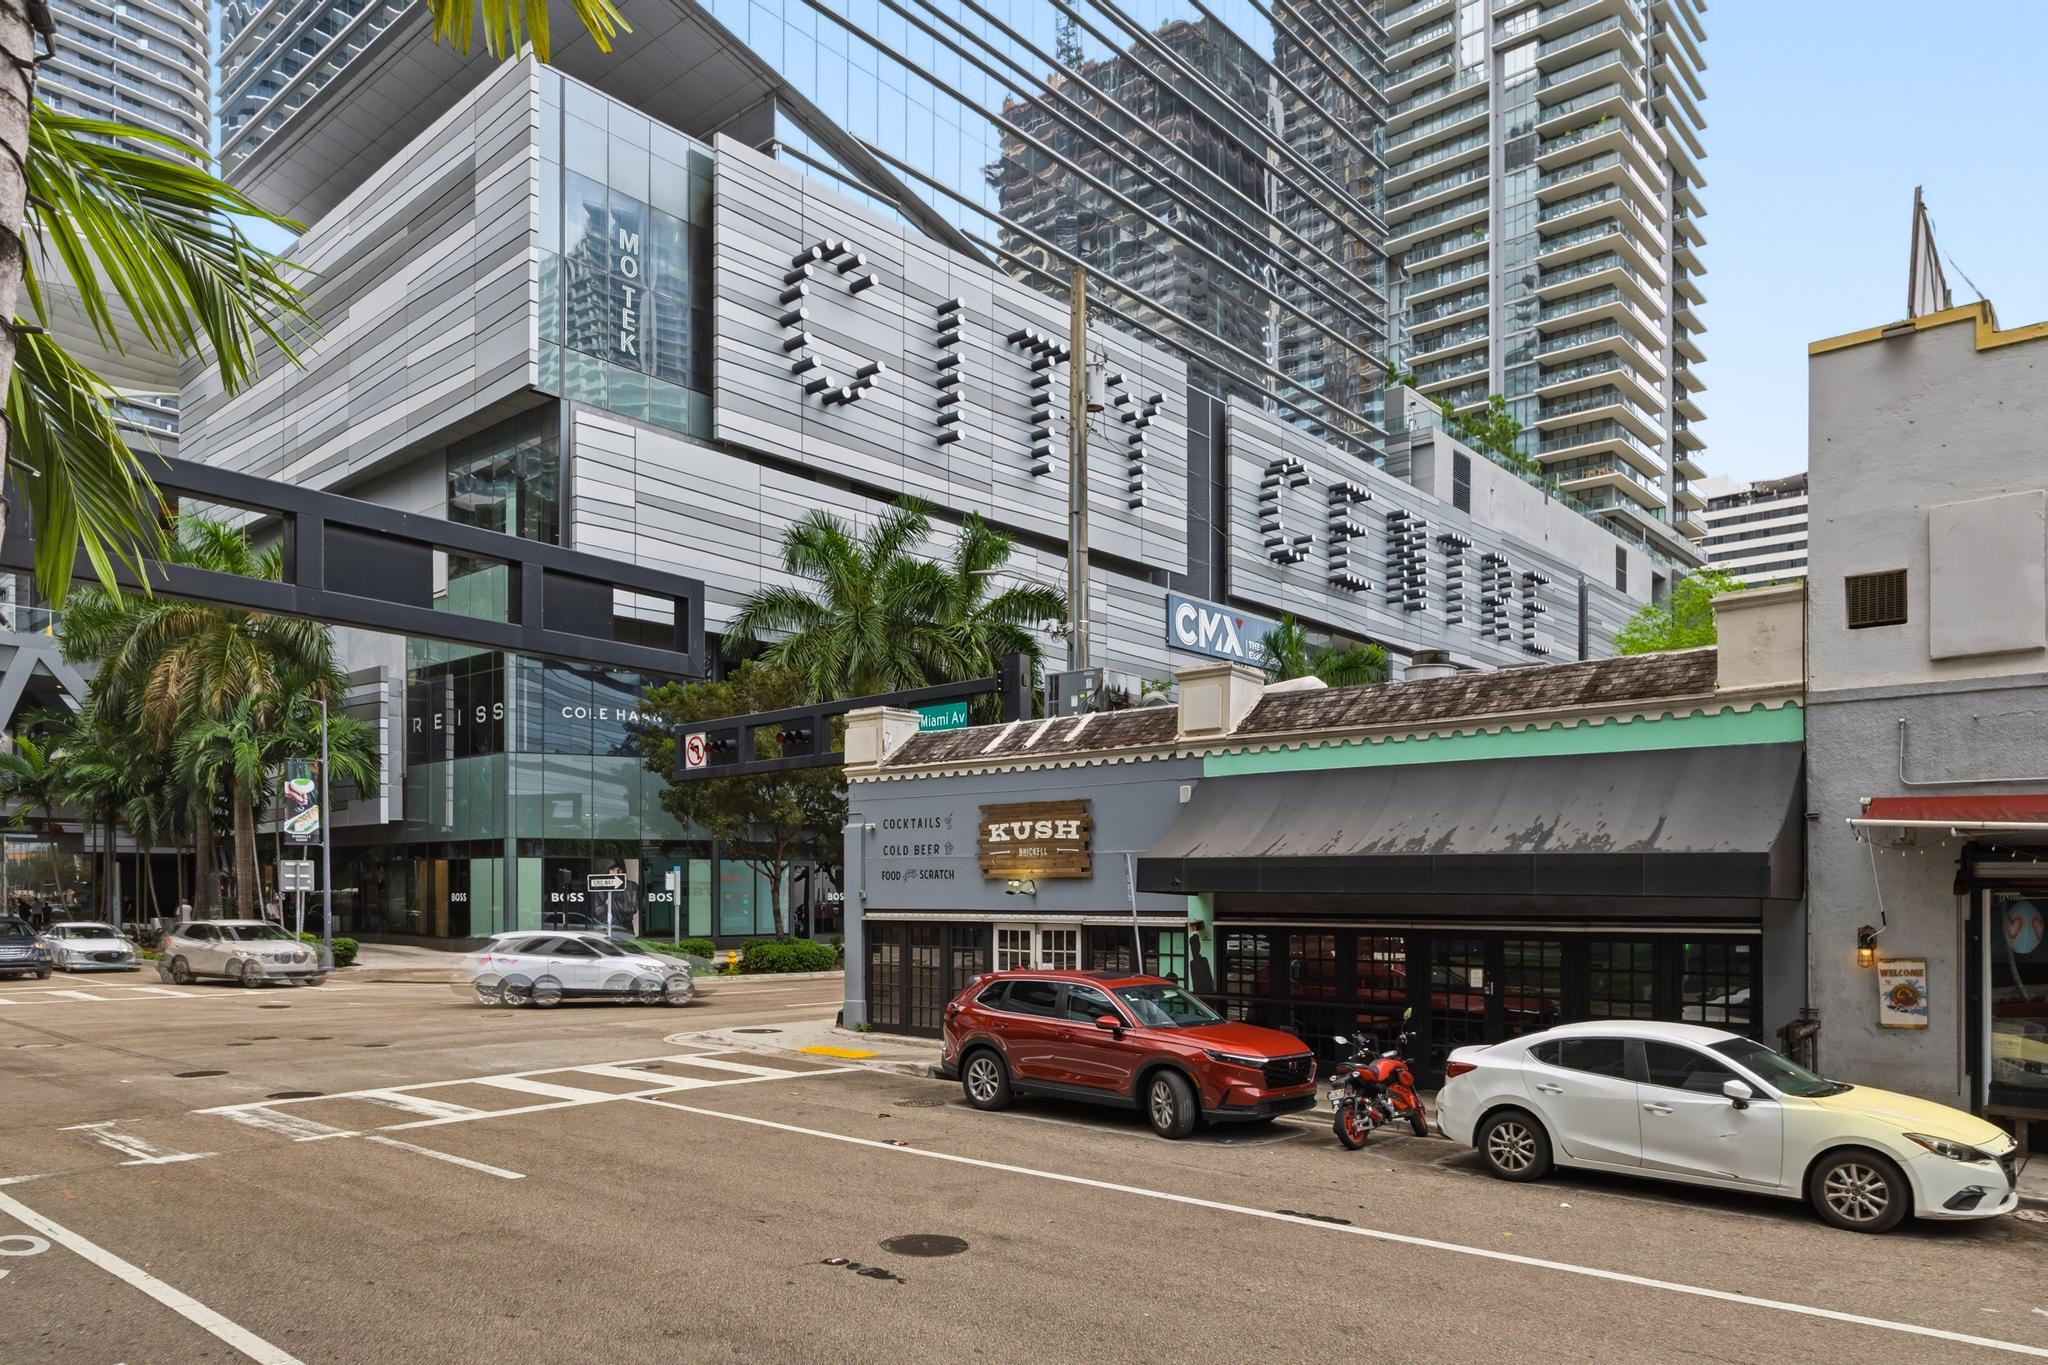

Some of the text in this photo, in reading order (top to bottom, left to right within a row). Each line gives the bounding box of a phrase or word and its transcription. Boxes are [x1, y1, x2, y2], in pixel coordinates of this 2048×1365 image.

[619, 228, 639, 356] MOTEK
[779, 237, 1552, 655] CITY CENTRE
[1175, 603, 1243, 656] CMX
[413, 702, 504, 733] REISS
[562, 706, 608, 720] COLE
[920, 711, 965, 728] Miami Av
[883, 817, 941, 829] COCKTAILS
[988, 820, 1081, 842] KUSH
[883, 844, 940, 856] COLD BEER
[881, 870, 901, 881] FOOD
[919, 869, 955, 880] SCRATCH
[451, 892, 467, 902] BOSS
[551, 892, 584, 902] BOSS
[648, 892, 673, 902] BOS
[827, 892, 845, 901] BOS
[1879, 968, 1925, 977] WELCOME
